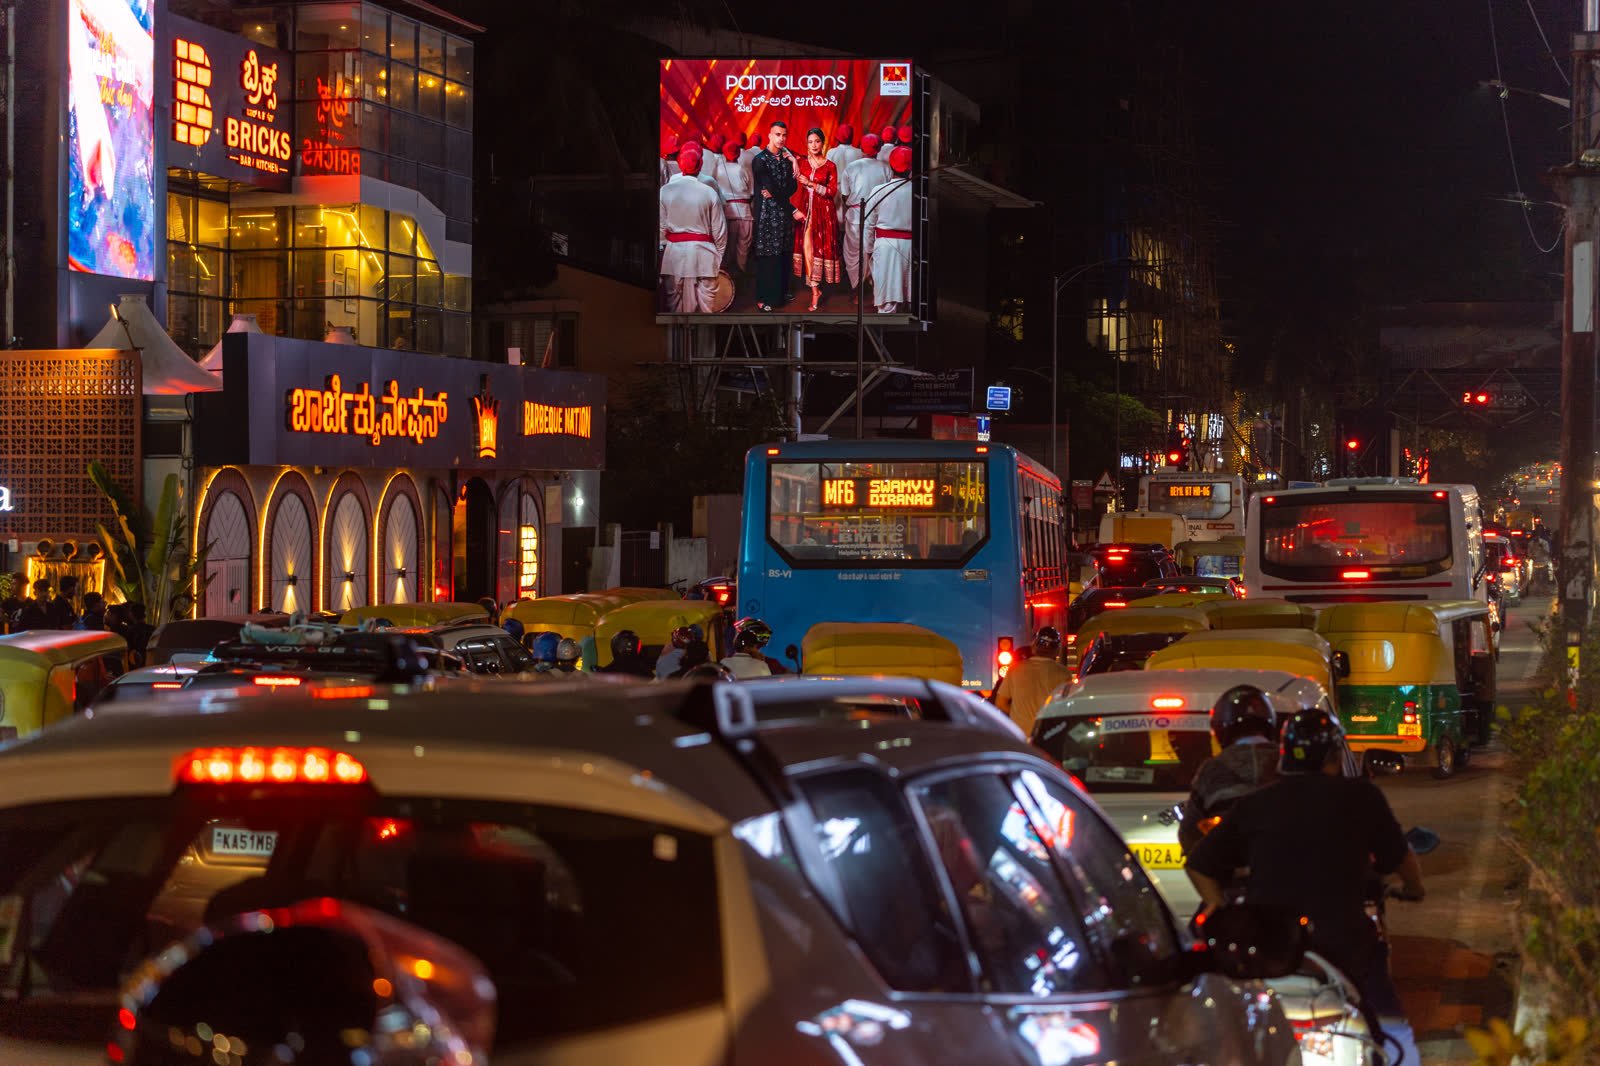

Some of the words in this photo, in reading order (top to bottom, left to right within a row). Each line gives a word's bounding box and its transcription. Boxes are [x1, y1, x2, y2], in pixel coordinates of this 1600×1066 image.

[227, 117, 291, 161] BRICKS
[524, 400, 563, 436] BARBEQUE
[564, 405, 591, 438] NATION
[483, 418, 494, 441] BN
[825, 480, 854, 505] MF6
[869, 493, 933, 506] DIRANAG
[838, 533, 904, 543] BMTC
[768, 569, 792, 579] BS-VI
[1104, 717, 1154, 731] BOMBAY
[223, 832, 274, 851] KA51MB
